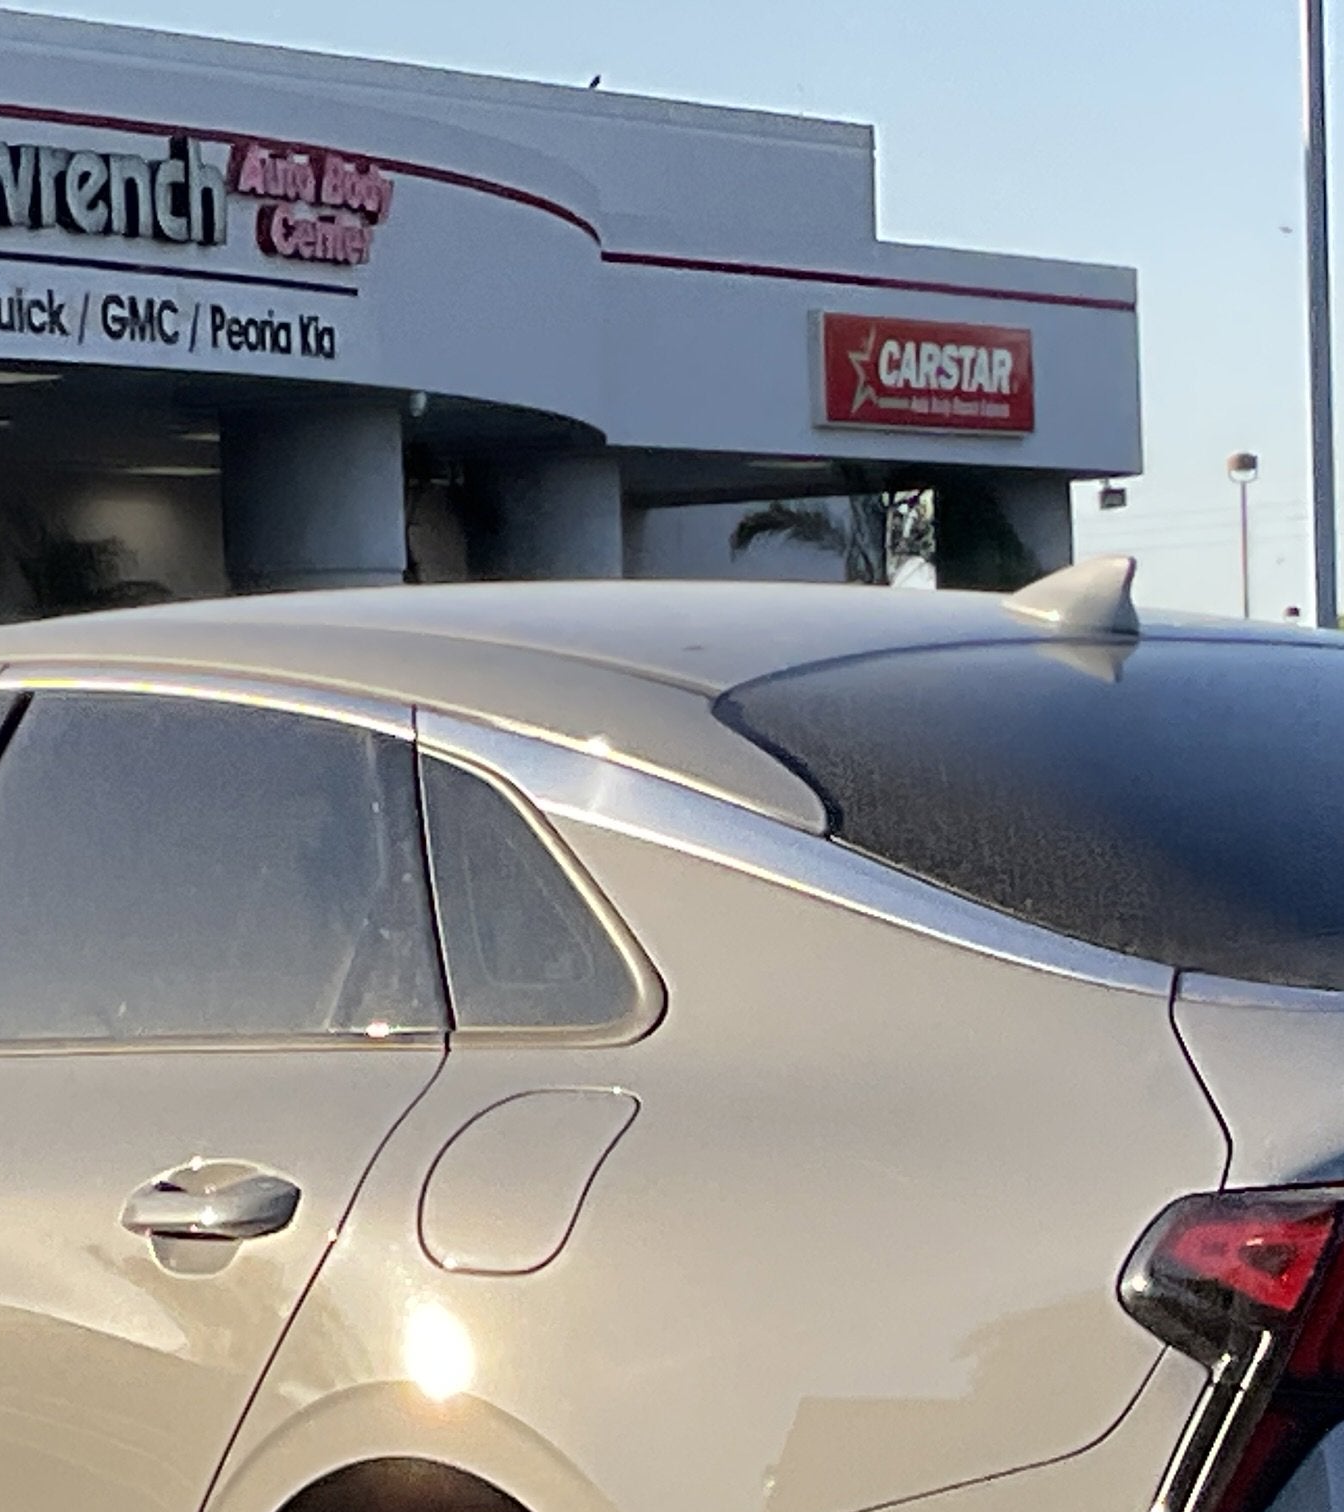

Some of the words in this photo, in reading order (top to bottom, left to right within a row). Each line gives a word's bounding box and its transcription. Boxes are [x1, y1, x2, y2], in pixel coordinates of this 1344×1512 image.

[230, 143, 316, 203] Auto
[319, 152, 394, 224] Body
[258, 202, 374, 265] Center
[101, 294, 180, 345] GMC
[209, 303, 293, 355] Peoria
[299, 314, 336, 360] Kia
[878, 338, 1013, 394] CARSTAR
